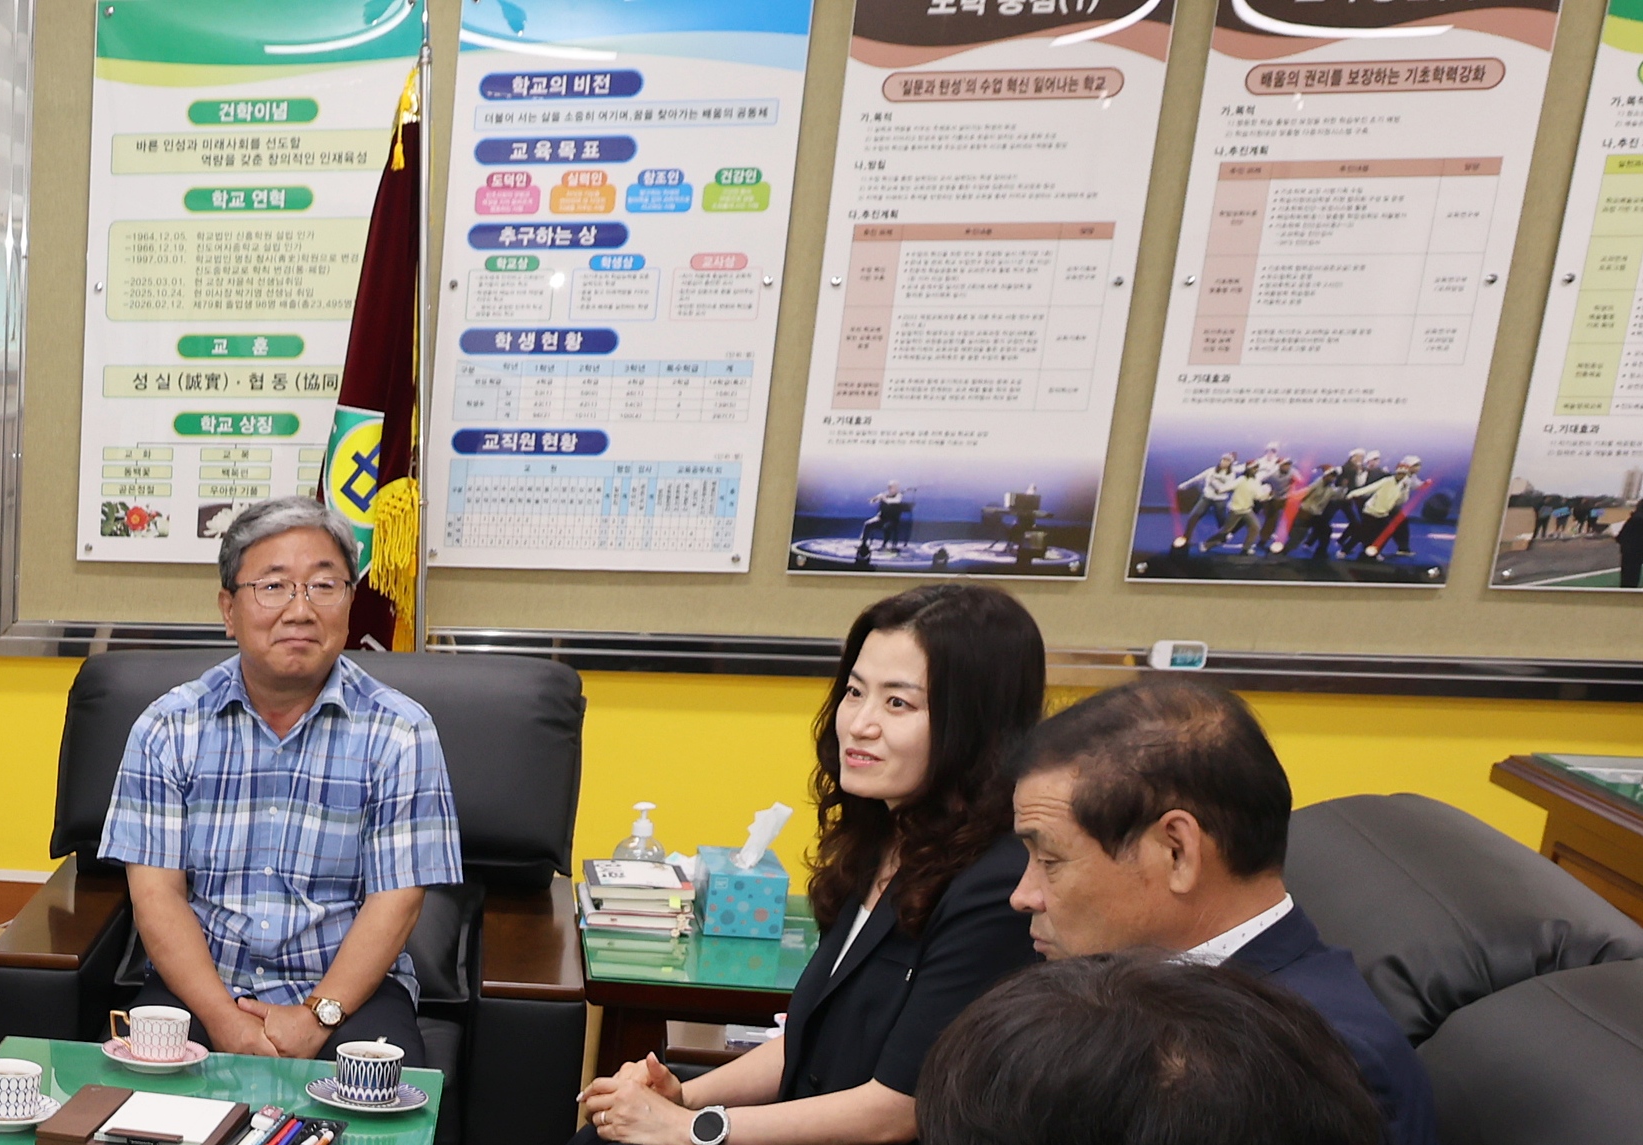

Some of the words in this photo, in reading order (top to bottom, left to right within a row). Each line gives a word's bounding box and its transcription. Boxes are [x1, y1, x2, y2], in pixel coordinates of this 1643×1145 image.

[512, 75, 567, 97] 학교의
[573, 73, 612, 95] 비전
[980, 77, 1002, 95] 수업
[1007, 76, 1030, 94] 혁신
[1034, 75, 1079, 93] 일어나는
[1083, 75, 1107, 91] 학교
[1260, 70, 1300, 89] 배움의
[1304, 69, 1343, 88] 권리를
[1347, 68, 1400, 86] 보장하는
[1404, 65, 1486, 84] 기초학력강화
[219, 101, 289, 122] 건학이념
[485, 112, 514, 125] 더불어
[564, 110, 595, 122] 소중히
[658, 108, 698, 120] 찾아가는
[136, 139, 159, 153] 바른
[164, 139, 198, 152] 인성과
[202, 137, 261, 151] 미래사회를
[266, 136, 301, 150] 선도할
[201, 153, 236, 167] 역량을
[240, 152, 263, 167] 갖춘
[268, 151, 315, 166] 창의적인
[320, 150, 368, 165] 인재육성
[491, 173, 527, 187] 도덕인
[567, 172, 603, 186] 실력인
[643, 170, 680, 185] 창조인
[720, 169, 757, 184] 건강인
[212, 190, 246, 209] 학교
[252, 189, 287, 208] 연혁
[297, 230, 315, 240] 인가
[498, 226, 573, 247] 추구하는
[578, 225, 597, 246] 상
[284, 242, 302, 252] 인가
[496, 257, 529, 270] 학교상
[600, 256, 634, 269] 학생상
[700, 255, 735, 269] 교사상
[201, 415, 233, 433] 학교
[239, 416, 273, 434] 상징
[482, 433, 537, 451] 교직원
[541, 432, 578, 452] 현황
